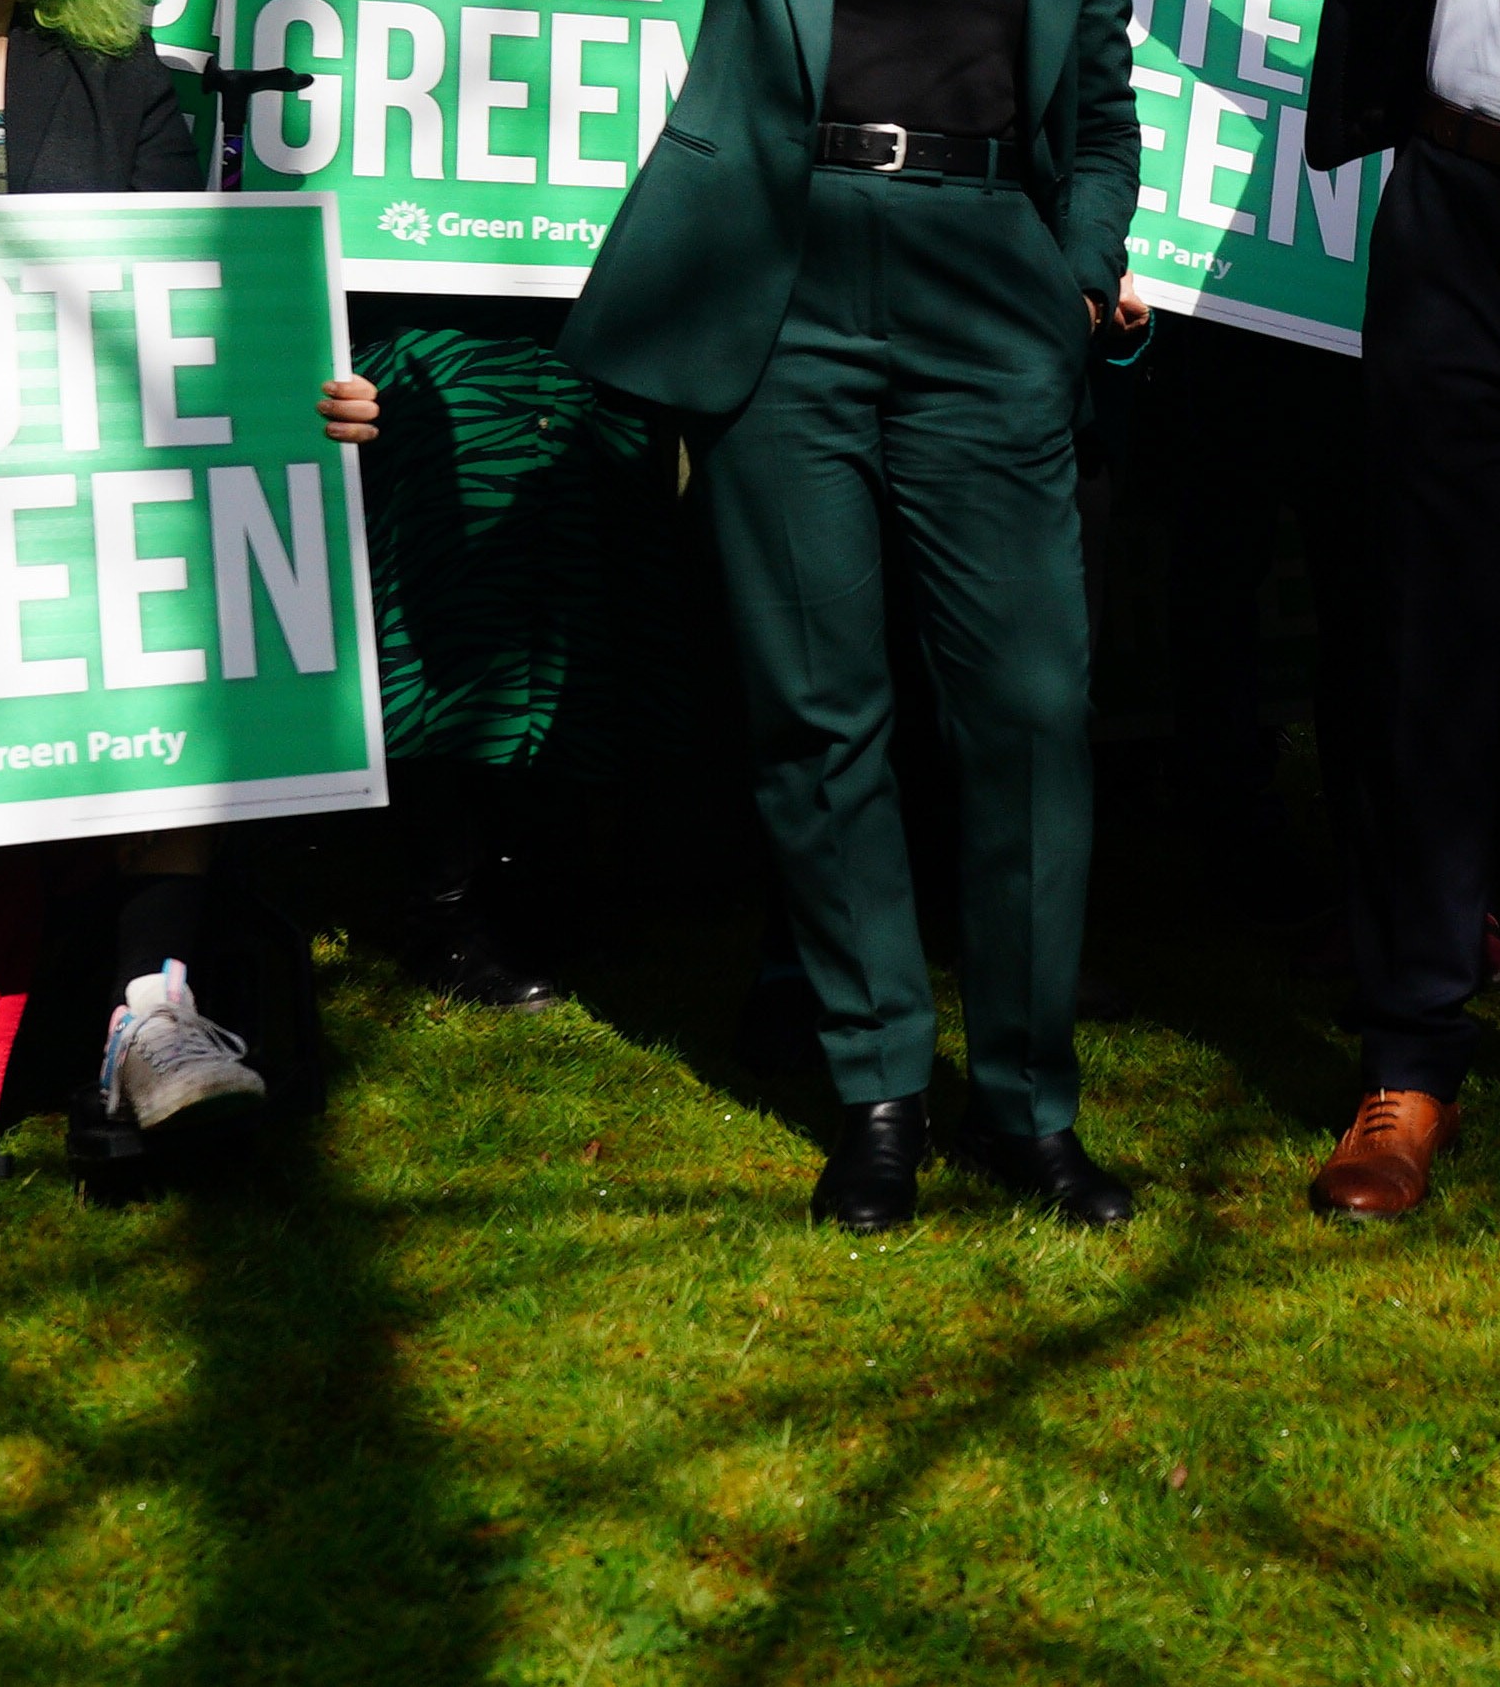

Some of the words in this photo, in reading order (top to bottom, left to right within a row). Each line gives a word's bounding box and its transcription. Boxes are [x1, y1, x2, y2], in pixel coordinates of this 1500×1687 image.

[438, 212, 523, 239] Green
[532, 216, 607, 249] Party
[1158, 239, 1232, 280] Party
[87, 727, 187, 768] Party
